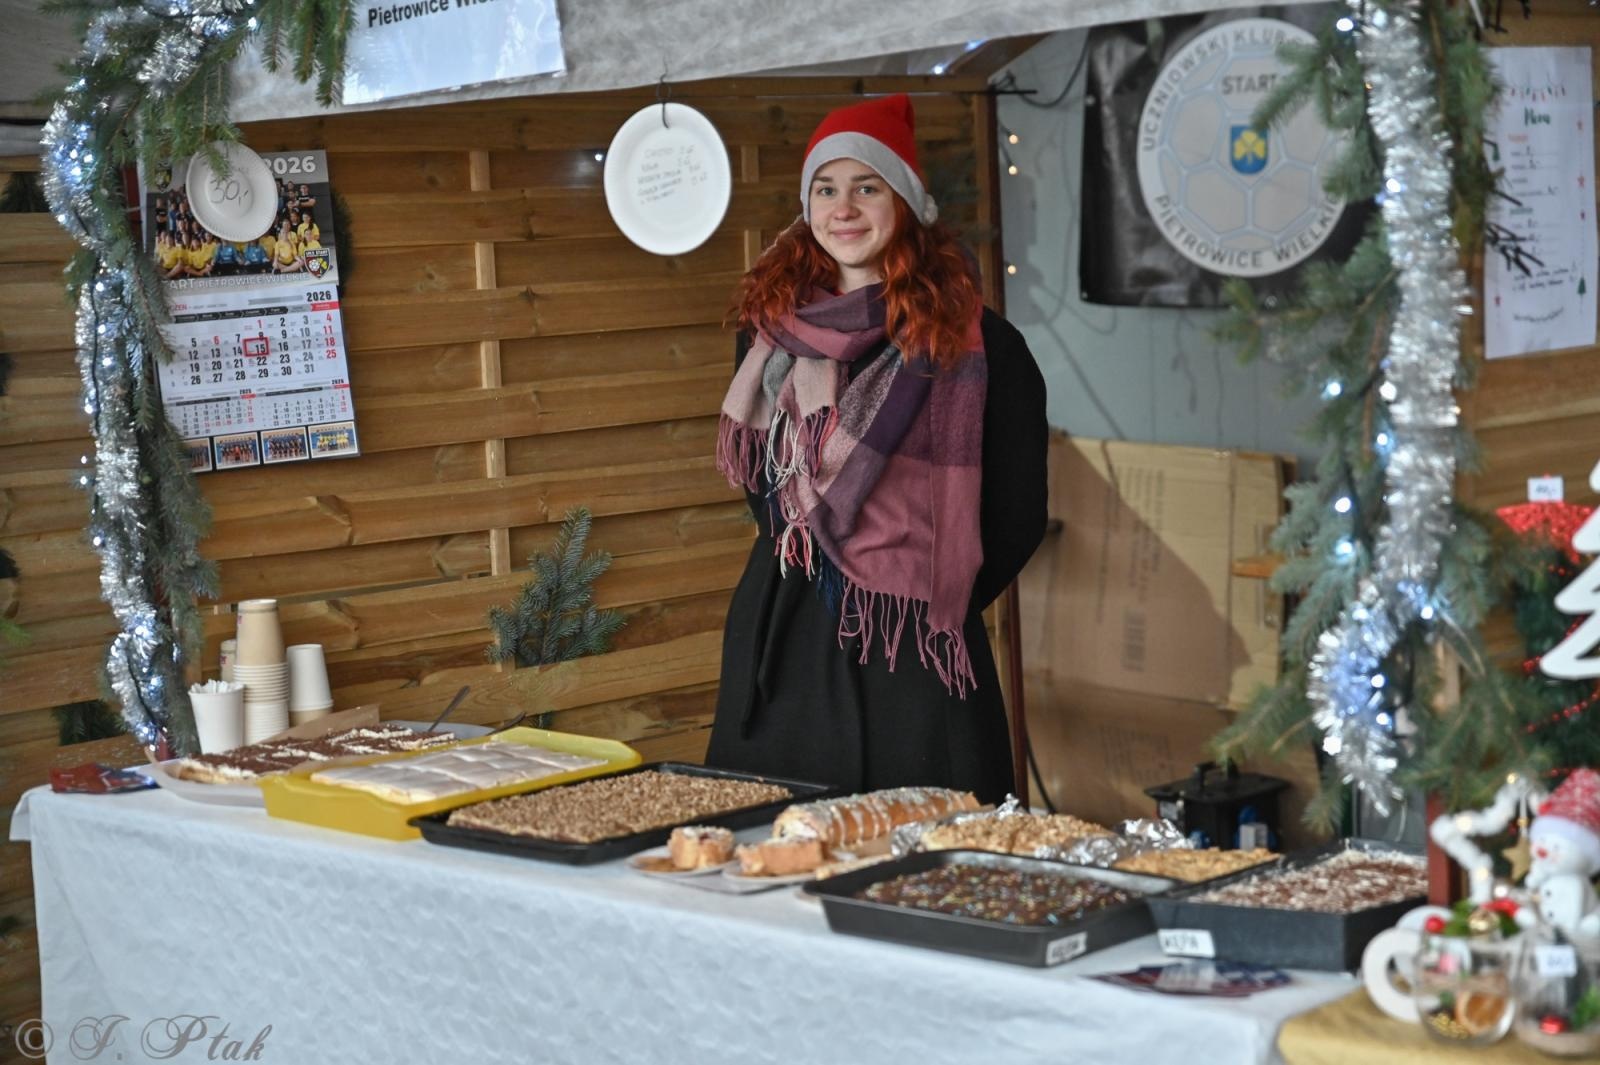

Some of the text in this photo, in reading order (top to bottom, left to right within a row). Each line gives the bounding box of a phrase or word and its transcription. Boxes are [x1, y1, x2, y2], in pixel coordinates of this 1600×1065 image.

[368, 0, 449, 27] Pietrowice
[1143, 33, 1230, 151] UCZNIOWSKI
[1222, 73, 1277, 95] START
[1155, 194, 1263, 268] PIETROWICE
[199, 276, 262, 289] PIETROWICE
[266, 273, 310, 283] WIELKIE
[306, 291, 332, 301] 2026
[257, 313, 332, 328] 1 2 3 4
[191, 337, 197, 348] 5
[213, 335, 220, 345] 6
[235, 333, 241, 343] 7
[281, 329, 287, 339] 9
[300, 327, 310, 337] 10
[323, 325, 333, 335] 11
[188, 337, 335, 360] 12 13 14 15 16 17 18
[189, 349, 337, 373] 19 20 21 22 23 24 25
[190, 363, 315, 385] 26 27 28 29 30 31
